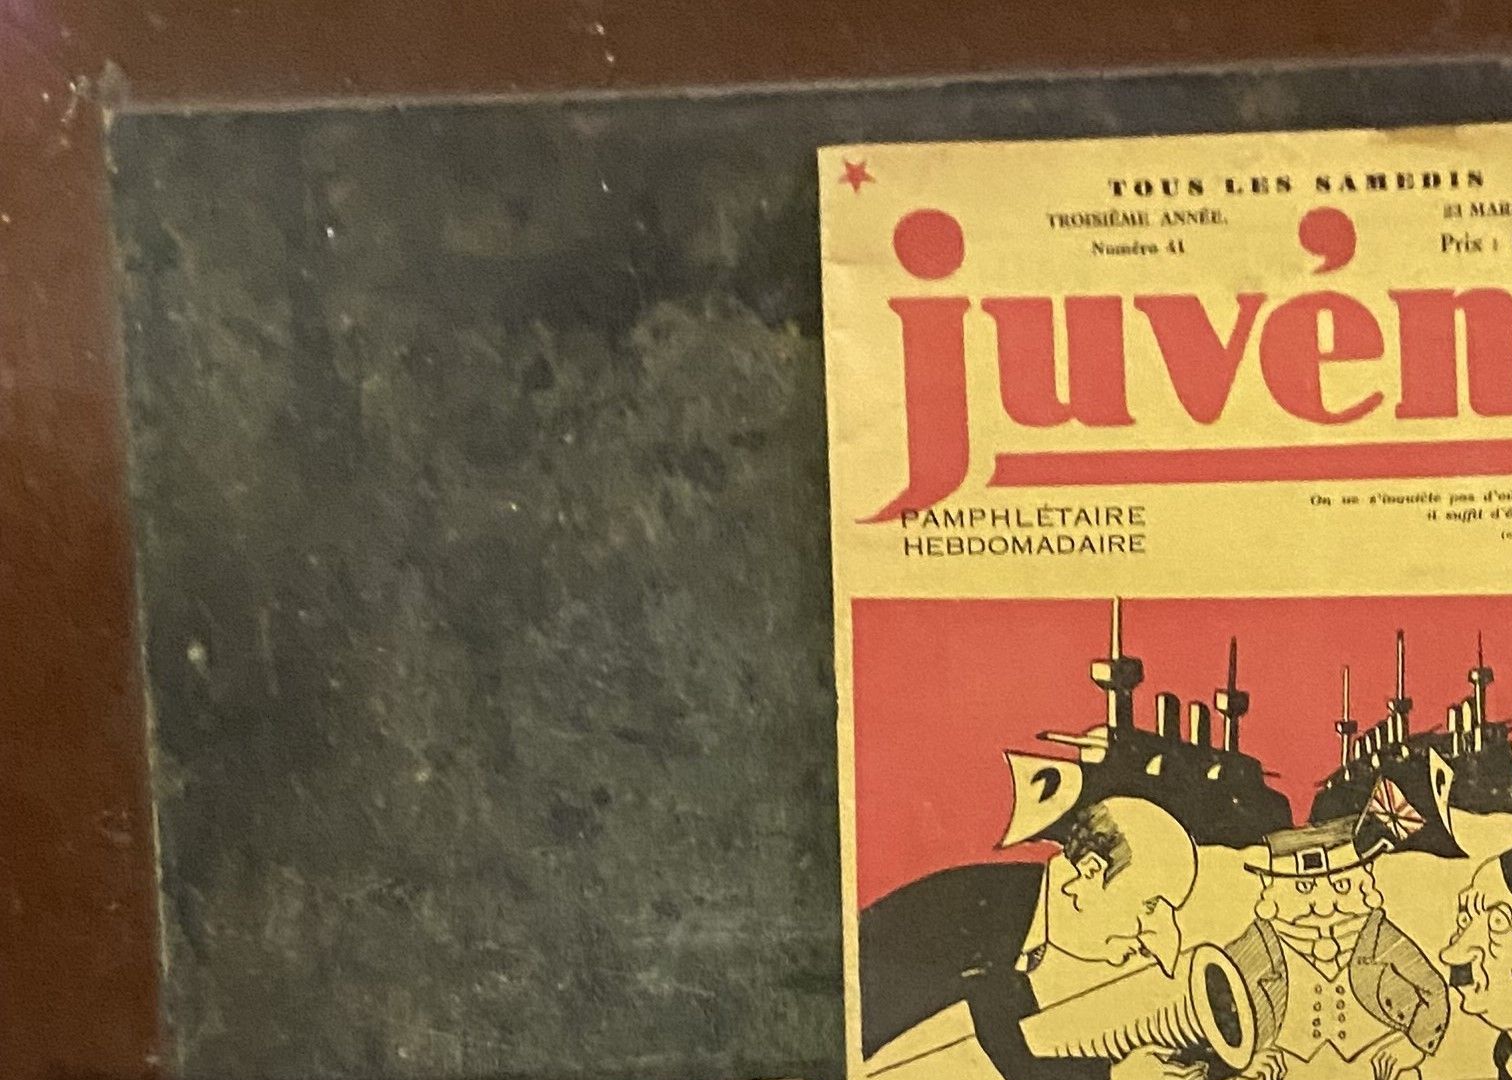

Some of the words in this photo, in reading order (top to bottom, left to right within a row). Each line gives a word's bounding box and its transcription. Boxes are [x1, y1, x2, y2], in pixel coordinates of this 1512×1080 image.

[1108, 177, 1203, 196] TOUS
[1225, 175, 1292, 194] LES
[1314, 170, 1484, 192] SAMEDIS
[1048, 209, 1149, 228] TROISIÈME
[1092, 240, 1159, 256] Numéro
[1441, 231, 1482, 252] Prix
[1449, 493, 1475, 505] pas
[901, 503, 1146, 529] PAMPHLÉTAIRE
[903, 533, 1146, 557] HEBDOMADAIRE
